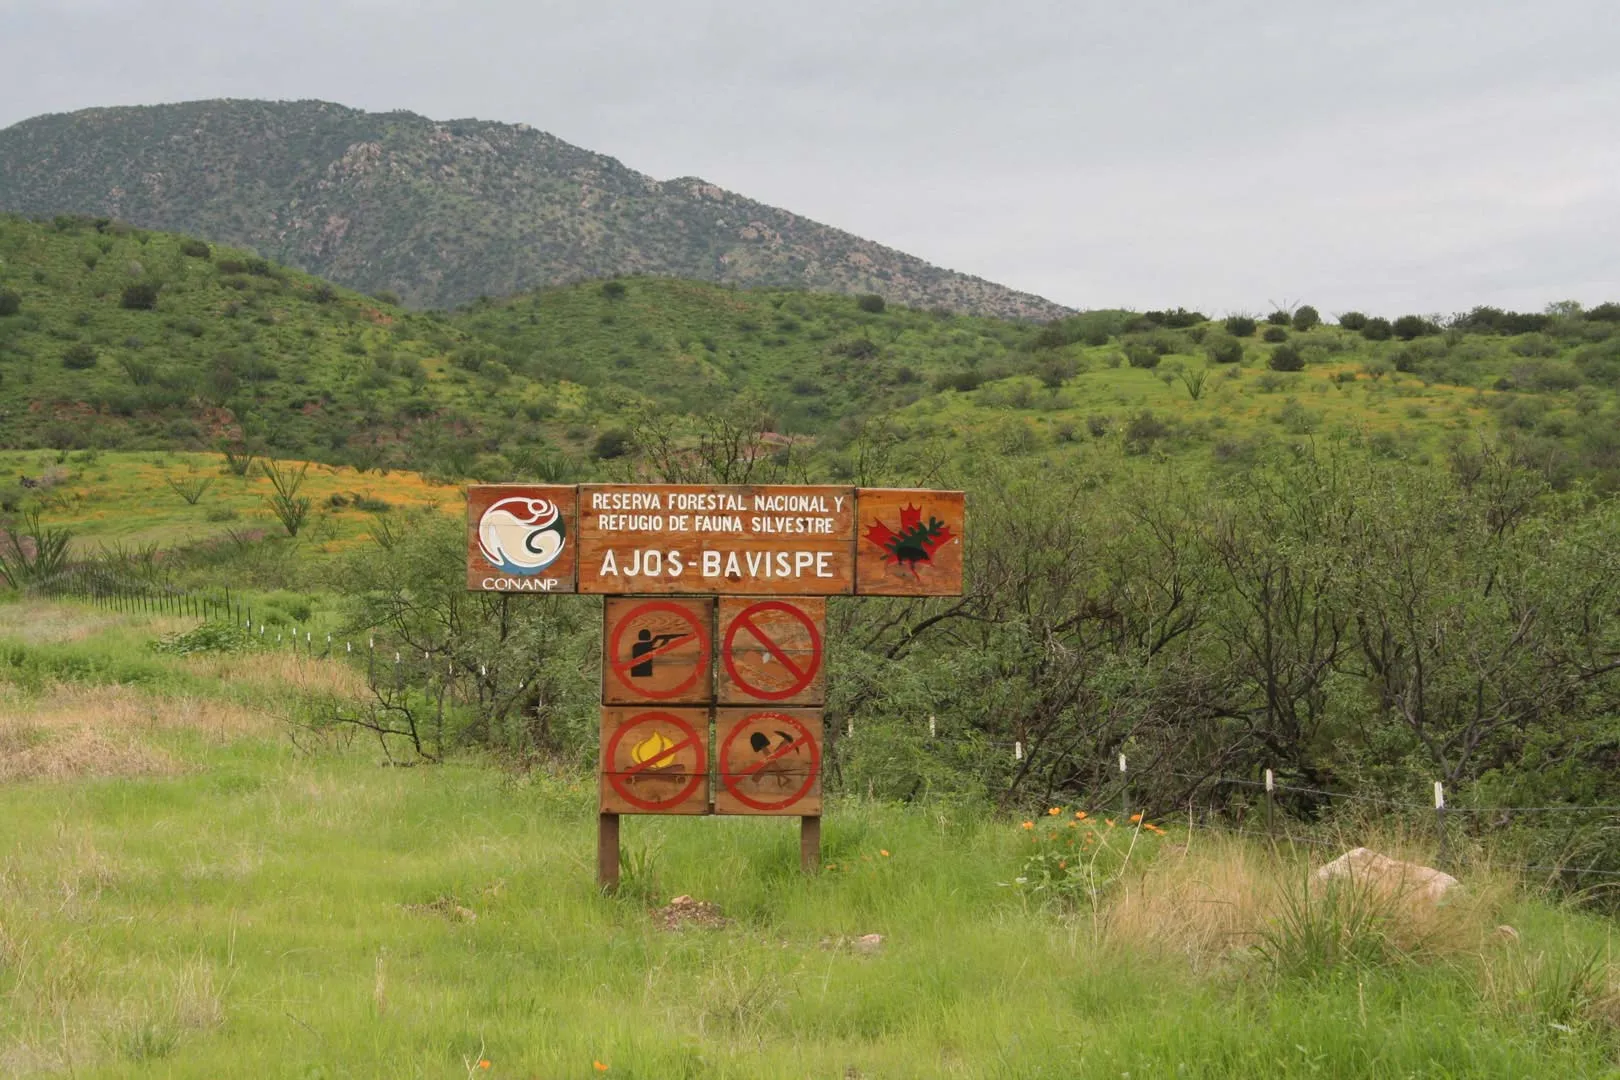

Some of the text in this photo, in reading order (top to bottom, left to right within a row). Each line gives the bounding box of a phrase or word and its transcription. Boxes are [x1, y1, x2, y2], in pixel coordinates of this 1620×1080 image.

[592, 493, 844, 513] RESERVA FORESTAL NACIONAL Y
[599, 515, 834, 534] REFUGIO DE FAUNA SILVESTRE
[482, 577, 558, 591] CONANP
